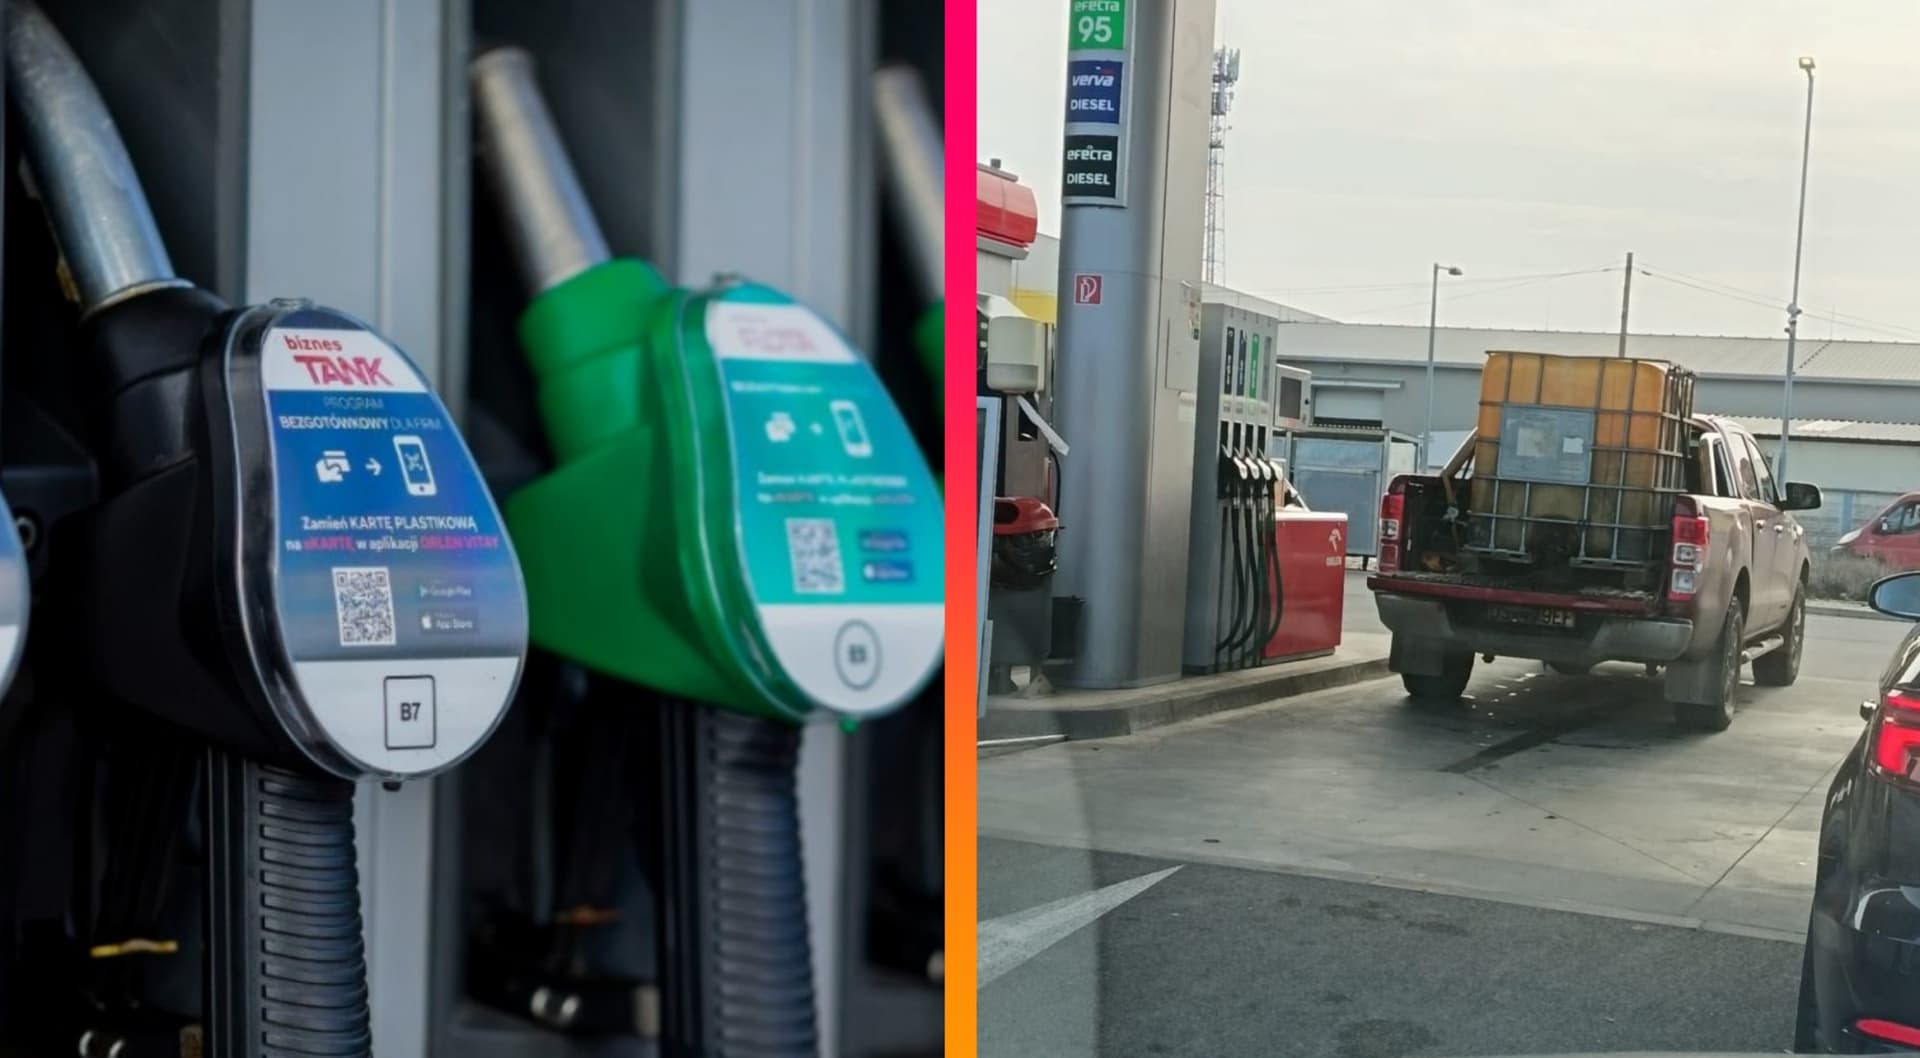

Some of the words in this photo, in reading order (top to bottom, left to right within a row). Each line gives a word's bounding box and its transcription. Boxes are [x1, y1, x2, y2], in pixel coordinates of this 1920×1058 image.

[1078, 15, 1112, 42] 95
[1072, 75, 1115, 87] verva
[1070, 98, 1115, 111] DIESEL
[1066, 149, 1113, 161] efecta
[1066, 172, 1110, 185] DIESEL
[284, 335, 342, 351] biznes
[293, 355, 393, 387] TANK
[323, 396, 384, 409] PROGRAM
[279, 413, 388, 429] BEZGOTÓWKOWY
[301, 515, 348, 530] Zamień
[350, 516, 394, 532] KARTĘ
[395, 516, 478, 533] PLASTIKOWĄ
[286, 539, 302, 550] na
[356, 539, 367, 550] w
[369, 536, 418, 552] aplikacji
[400, 702, 421, 721] B7
